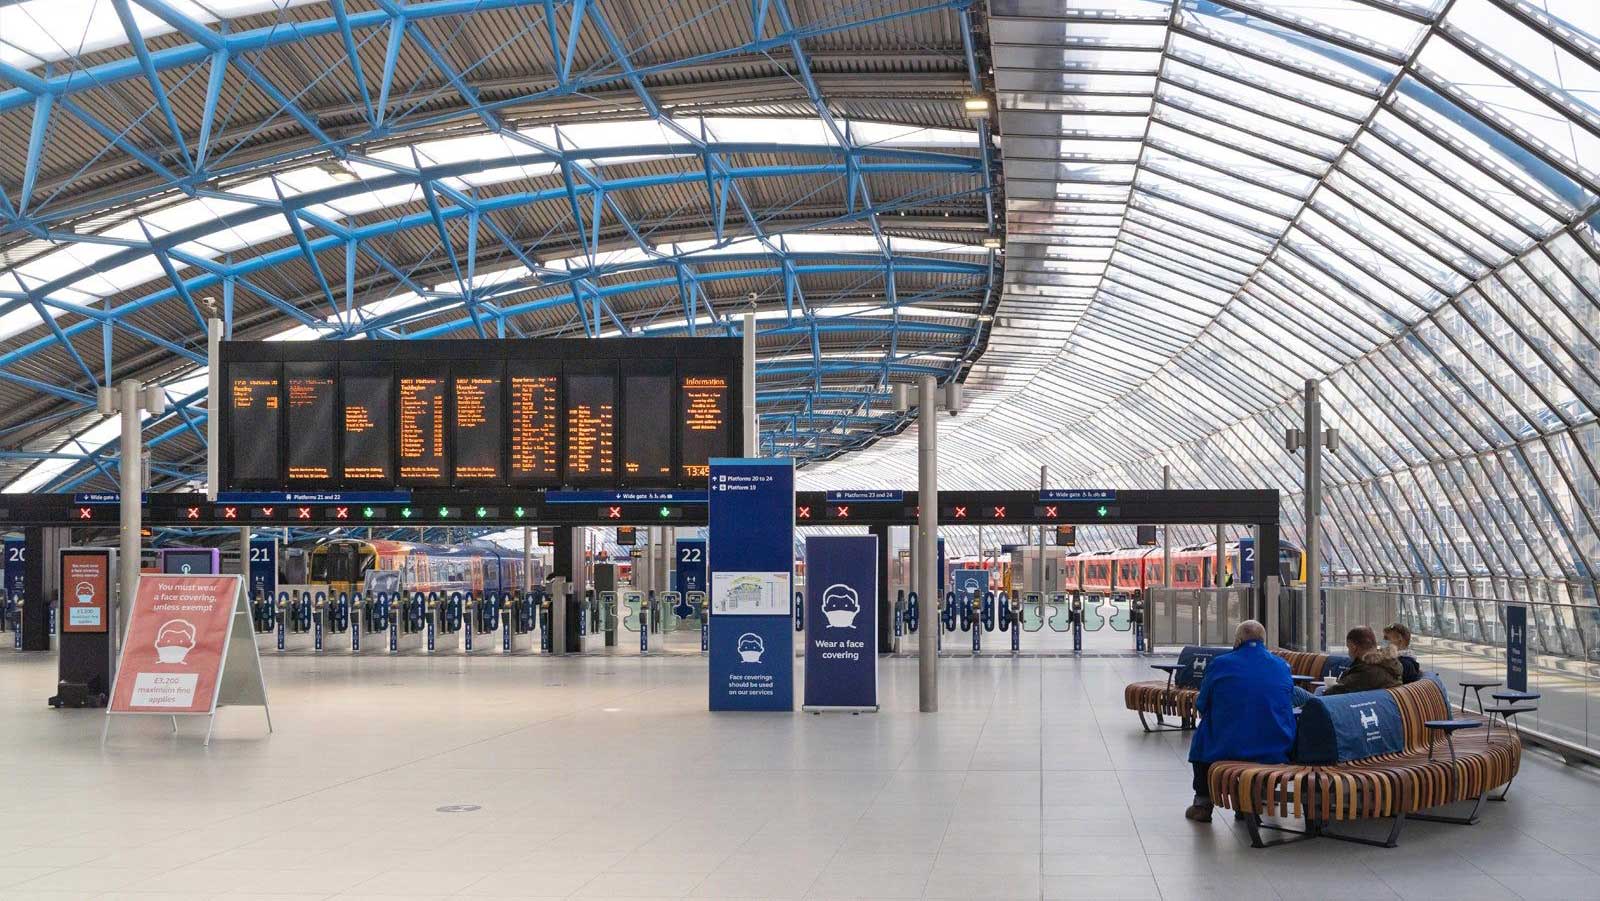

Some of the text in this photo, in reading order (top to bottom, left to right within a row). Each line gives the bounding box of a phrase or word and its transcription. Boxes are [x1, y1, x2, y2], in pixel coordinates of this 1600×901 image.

[687, 467, 709, 477] 13:45
[250, 548, 270, 562] 21
[681, 548, 701, 562] 22
[1245, 547, 1255, 561] 2
[158, 583, 174, 592] You
[174, 584, 196, 592] must
[161, 593, 178, 601] face
[179, 593, 217, 603] covering,
[153, 603, 213, 613] unless exempt
[815, 639, 838, 648] Wear
[846, 639, 864, 648] face
[822, 651, 859, 661] covering
[153, 677, 179, 685] £3,200
[744, 674, 773, 682] coverings
[138, 686, 191, 694] maximum fine
[148, 695, 176, 704] applies
